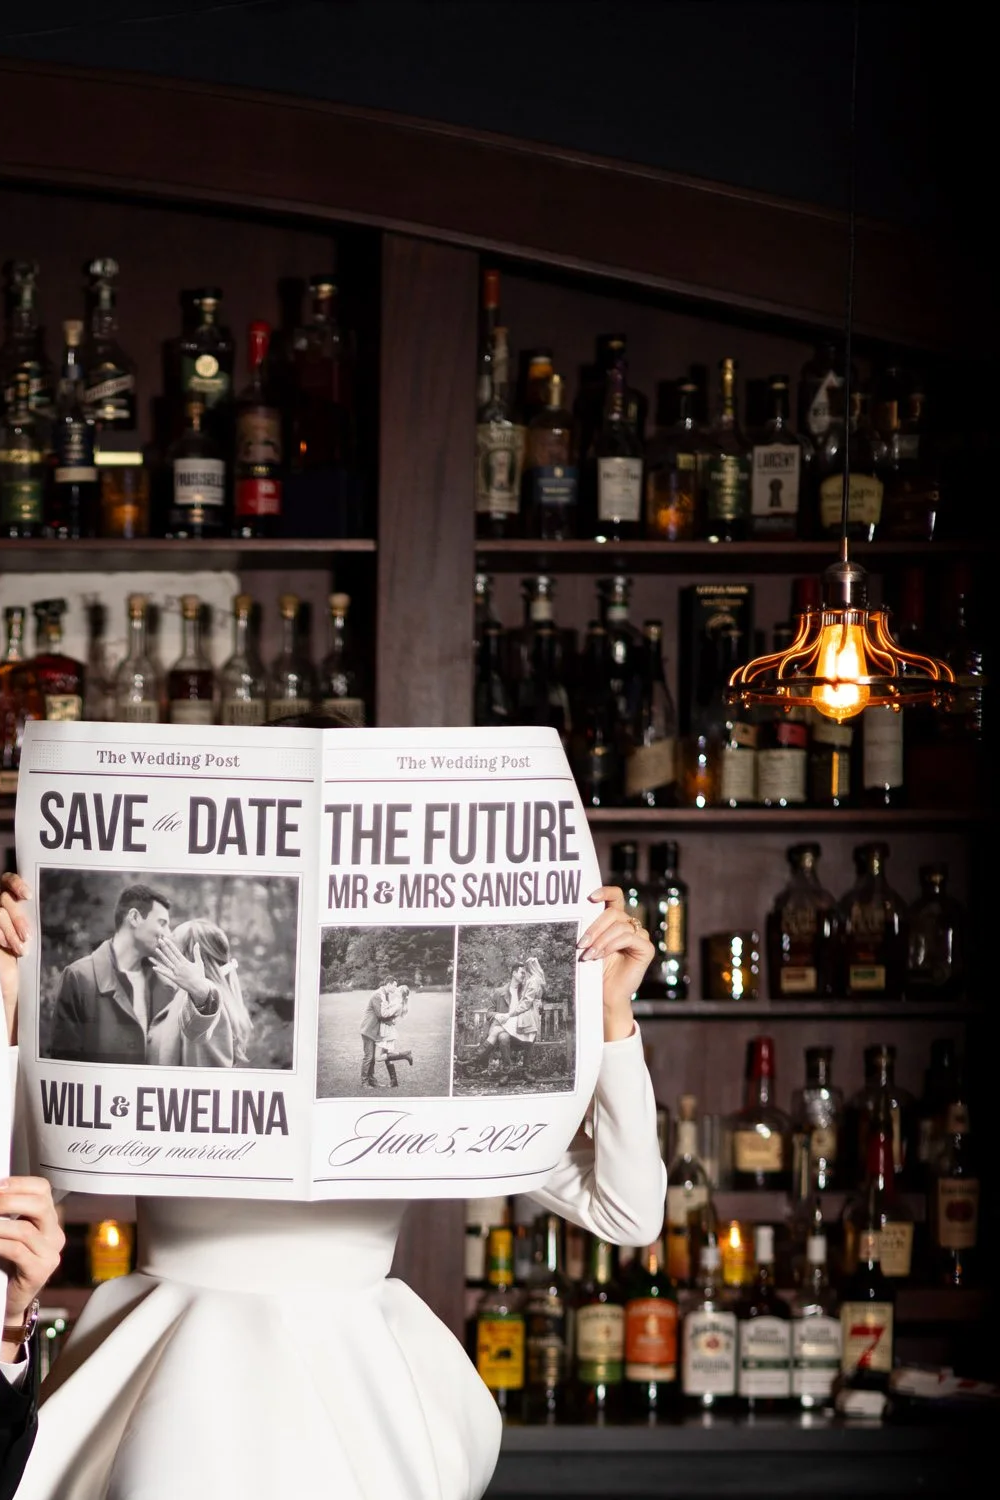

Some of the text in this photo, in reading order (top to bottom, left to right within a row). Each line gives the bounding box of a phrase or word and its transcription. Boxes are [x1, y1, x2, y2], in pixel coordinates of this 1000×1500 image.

[97, 750, 240, 771] The Wedding Post
[397, 755, 531, 772] The Wedding Post
[40, 791, 302, 857] SAVE the DATE
[325, 801, 579, 865] THE FUTURE
[328, 870, 581, 909] MR & MRS SANISLOW
[40, 1080, 288, 1135] WILL & EWELINA
[67, 1140, 256, 1167] are getting married!
[328, 1110, 549, 1167] June 5, 2027
